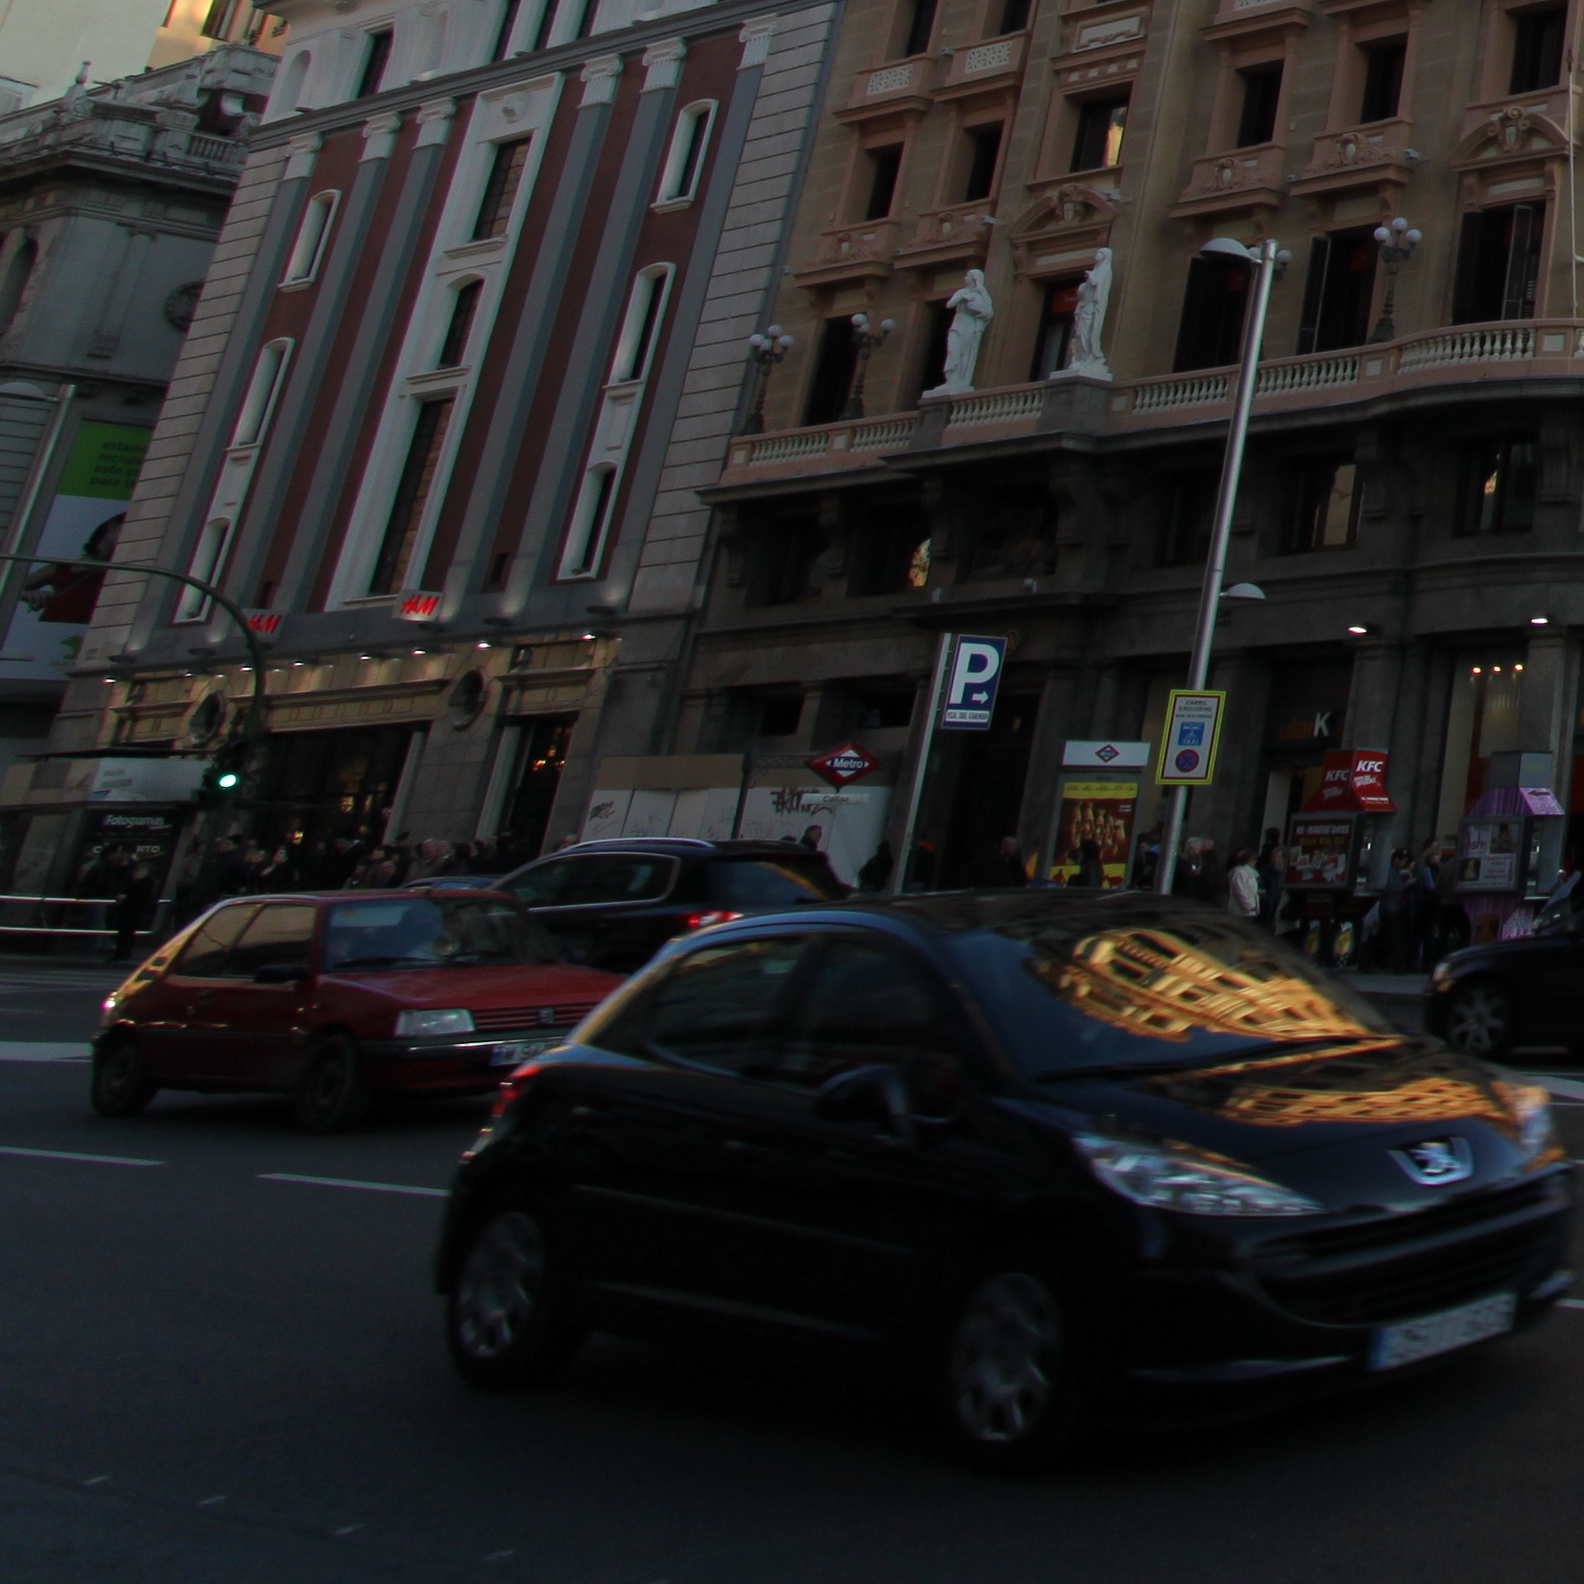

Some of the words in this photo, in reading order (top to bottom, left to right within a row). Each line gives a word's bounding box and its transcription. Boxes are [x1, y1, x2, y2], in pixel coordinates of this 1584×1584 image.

[949, 642, 1000, 705] P
[833, 756, 864, 770] Metro
[1355, 760, 1384, 773] KFC
[1324, 769, 1350, 782] KFC
